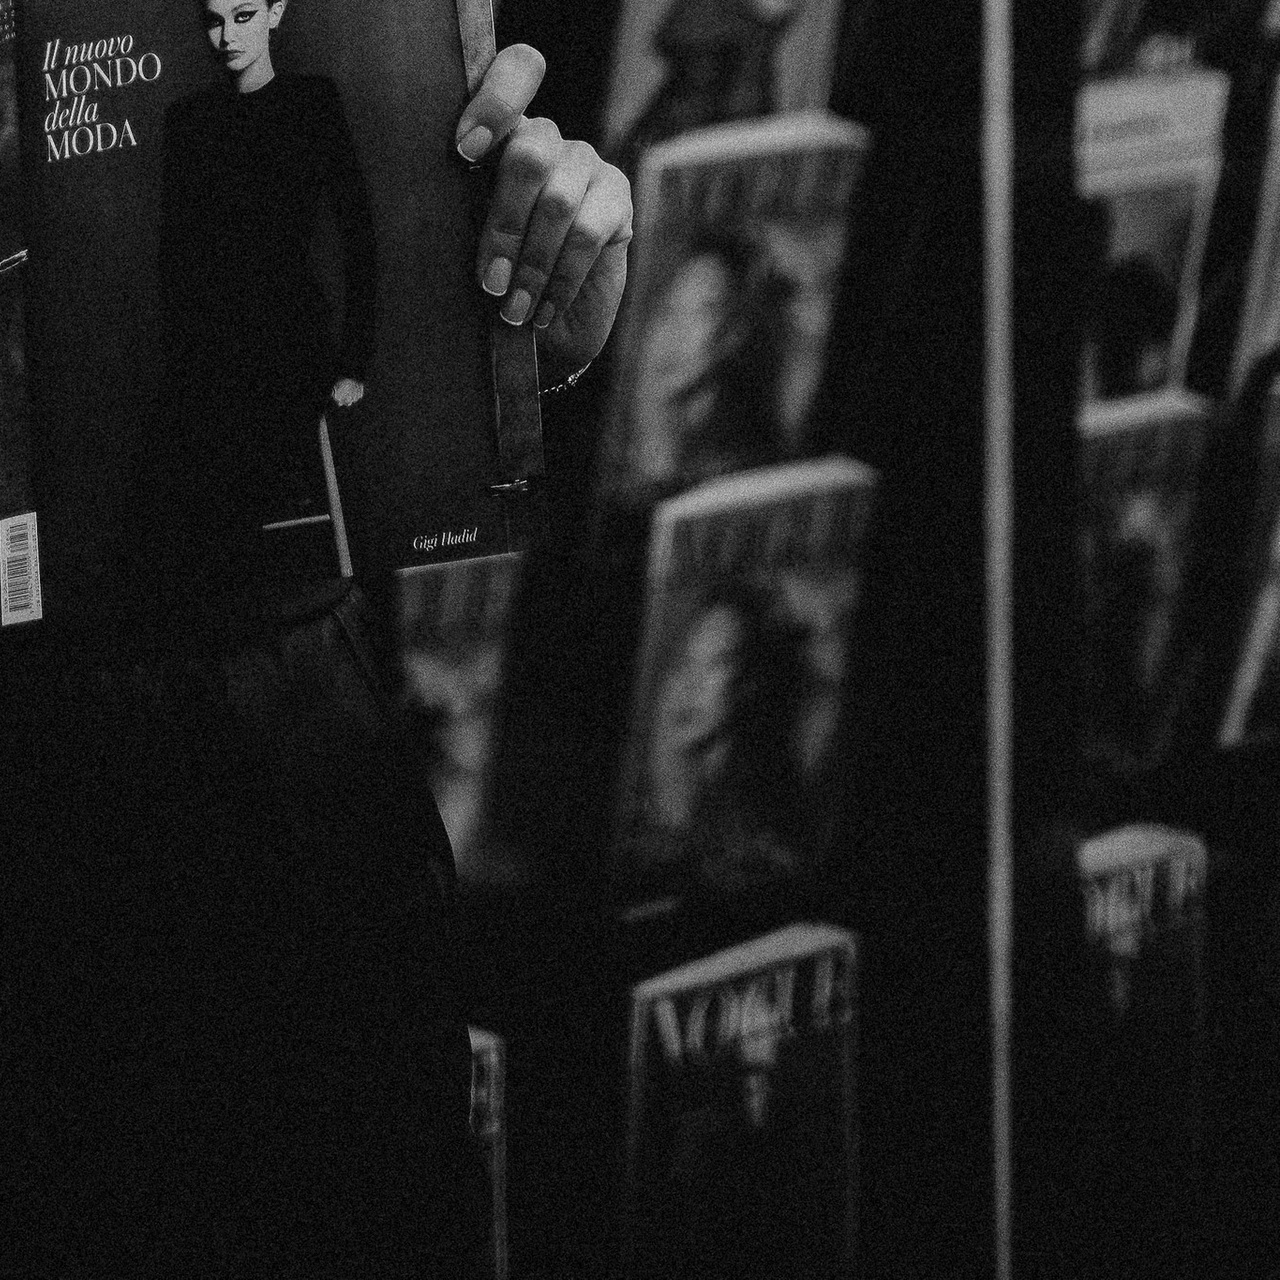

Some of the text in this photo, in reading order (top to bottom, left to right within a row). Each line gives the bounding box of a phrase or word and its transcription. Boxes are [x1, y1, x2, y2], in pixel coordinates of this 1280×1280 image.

[42, 38, 60, 71] Il
[64, 34, 134, 66] nuovo
[44, 52, 162, 101] MONDO
[44, 95, 99, 133] della
[46, 118, 138, 163] MODA
[413, 533, 438, 551] Gigi
